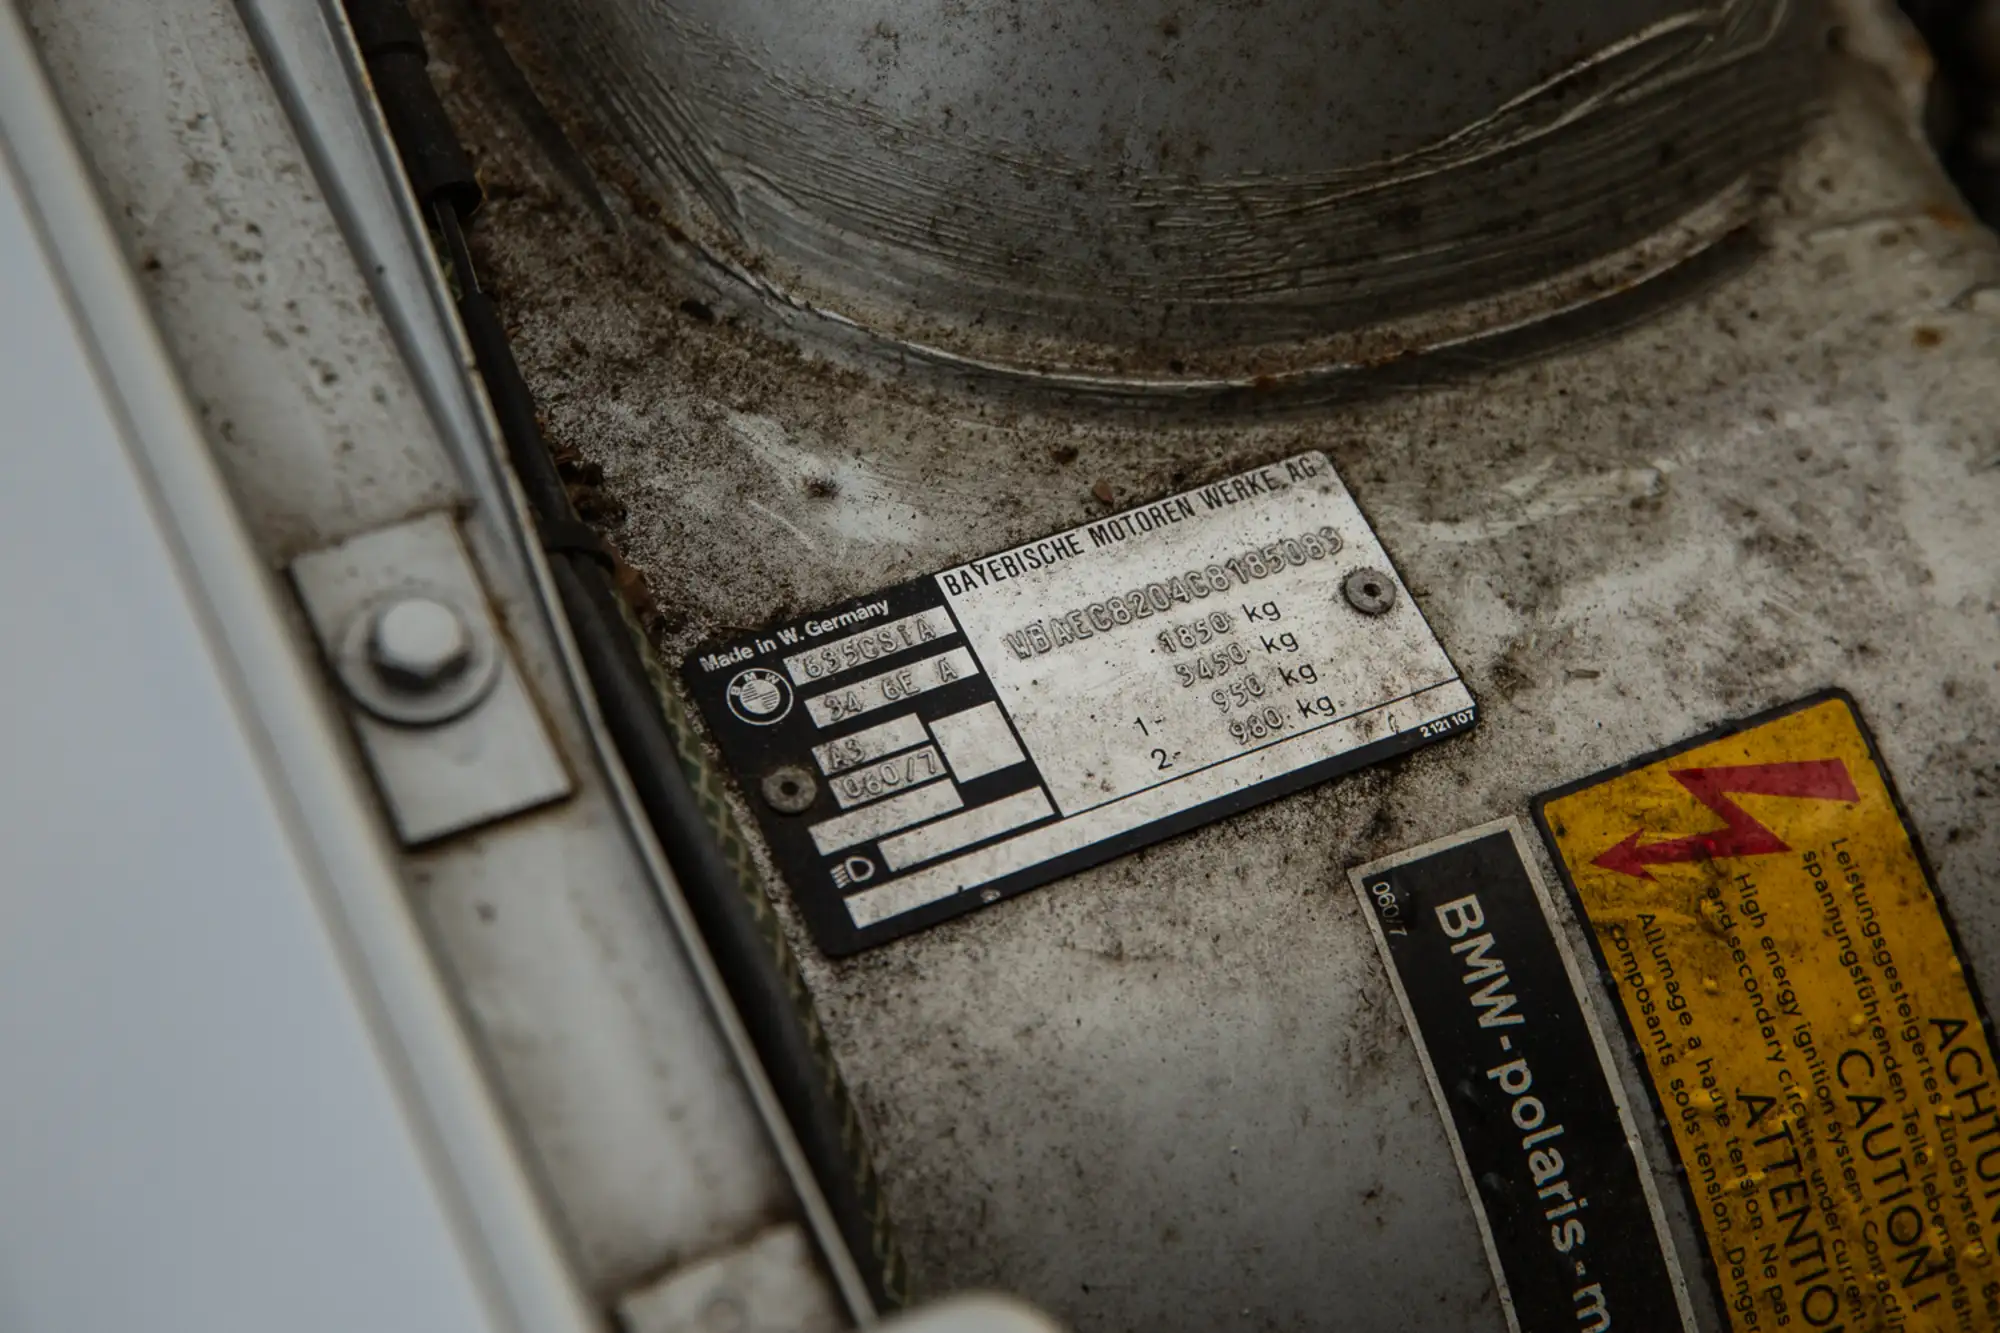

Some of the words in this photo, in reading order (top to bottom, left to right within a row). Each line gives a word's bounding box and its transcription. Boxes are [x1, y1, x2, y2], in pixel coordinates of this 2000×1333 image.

[1087, 499, 1196, 549] MOTOREN
[1198, 468, 1280, 511] WERKE
[1287, 455, 1319, 483] AG
[700, 647, 755, 674] Made
[757, 637, 778, 654] in
[776, 627, 805, 646] W.
[804, 599, 890, 638] Germany
[1156, 610, 1231, 653] 1850
[1241, 600, 1282, 623] kg
[730, 671, 781, 697] BMW
[937, 657, 959, 684] A
[1174, 641, 1249, 689] 3450
[1258, 631, 1300, 655] kg
[1211, 673, 1266, 714] 950
[1276, 663, 1319, 687] kg
[1228, 705, 1284, 746] 980
[1294, 695, 1337, 720] kg
[842, 748, 938, 800] 060/7
[1637, 913, 1695, 1027] Allumage
[1735, 873, 1768, 930] High
[1760, 935, 1803, 1017] energy
[1793, 1021, 1837, 1116] ignition
[1610, 923, 1678, 1067] composants
[1670, 1077, 1701, 1138] sous
[1687, 1035, 1703, 1051] a
[1707, 887, 1738, 932] and
[1727, 935, 1787, 1063] secondary
[1810, 1168, 1841, 1232] under
[1695, 1056, 1732, 1130] haute
[1902, 1107, 1930, 1167] Teile
[1759, 1242, 1781, 1281] Ne
[1765, 1283, 1792, 1328] pas
